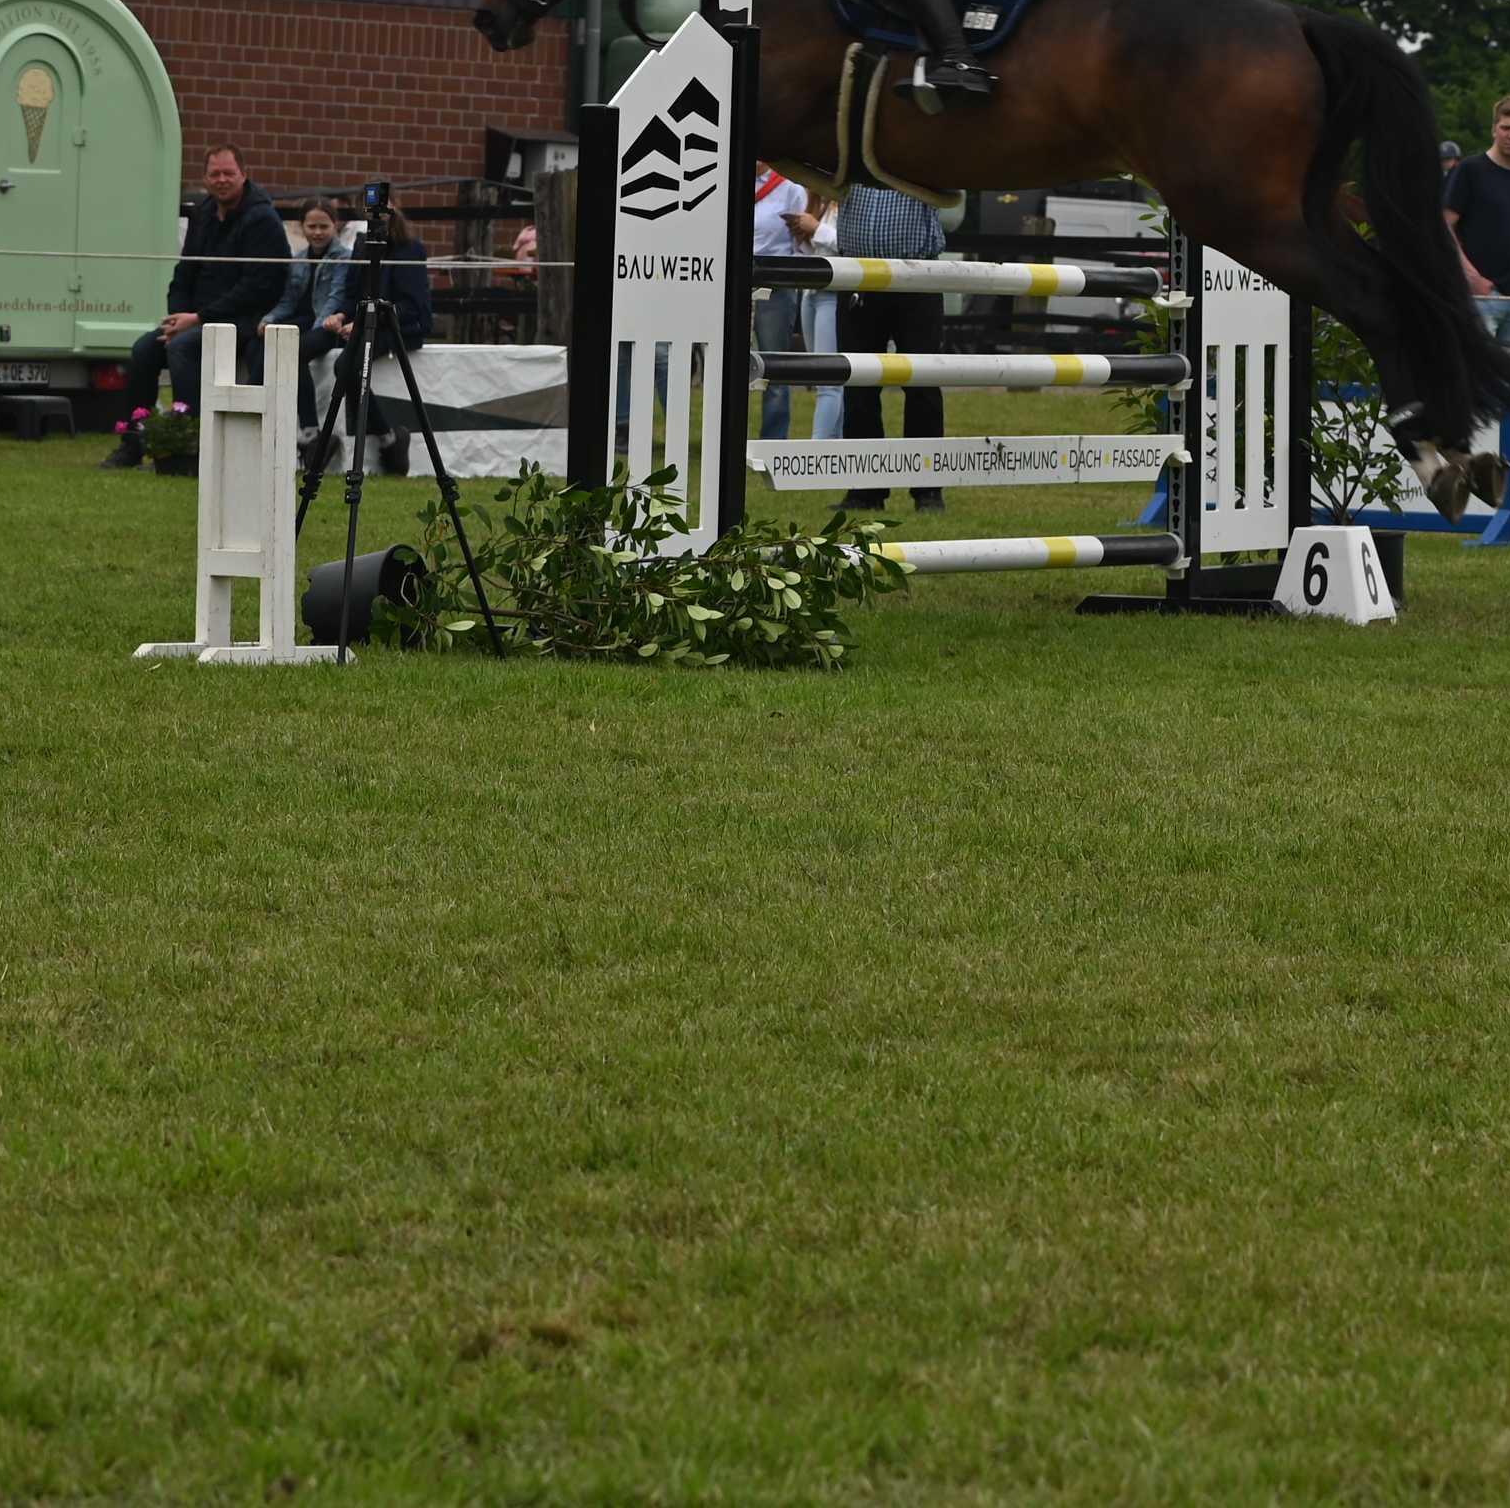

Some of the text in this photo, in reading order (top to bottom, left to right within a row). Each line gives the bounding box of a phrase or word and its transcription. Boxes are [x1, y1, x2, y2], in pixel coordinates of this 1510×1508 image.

[27, 363, 48, 381] 370
[773, 448, 1162, 476] PROJEKTENTWICKLUNG BAUUNTERNEHMUNG DACH FASSADE
[1302, 542, 1330, 606] 6
[1361, 542, 1378, 606] 6
